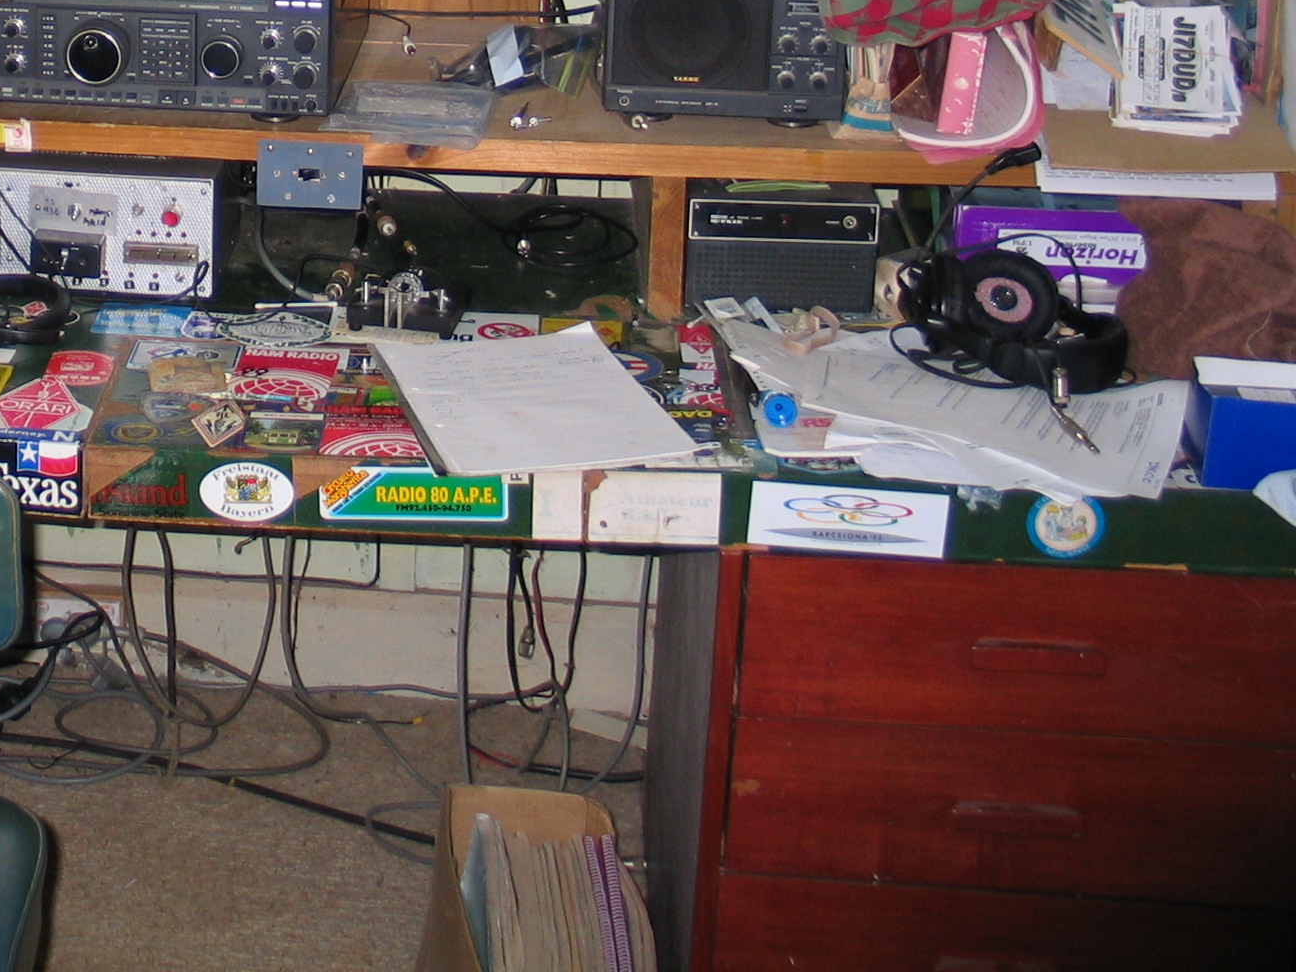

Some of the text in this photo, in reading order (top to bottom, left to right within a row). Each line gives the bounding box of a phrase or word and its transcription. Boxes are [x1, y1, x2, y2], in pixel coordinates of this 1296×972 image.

[1045, 246, 1138, 265] Horizon
[245, 348, 338, 361] HAM RADIO
[0, 400, 72, 414] ORARI
[213, 463, 280, 482] Freistaat
[376, 486, 498, 504] RADIO 80 A.P.E.
[621, 492, 712, 508] Amateur
[220, 504, 275, 518] Bayern
[811, 530, 869, 542] BARCELONA
